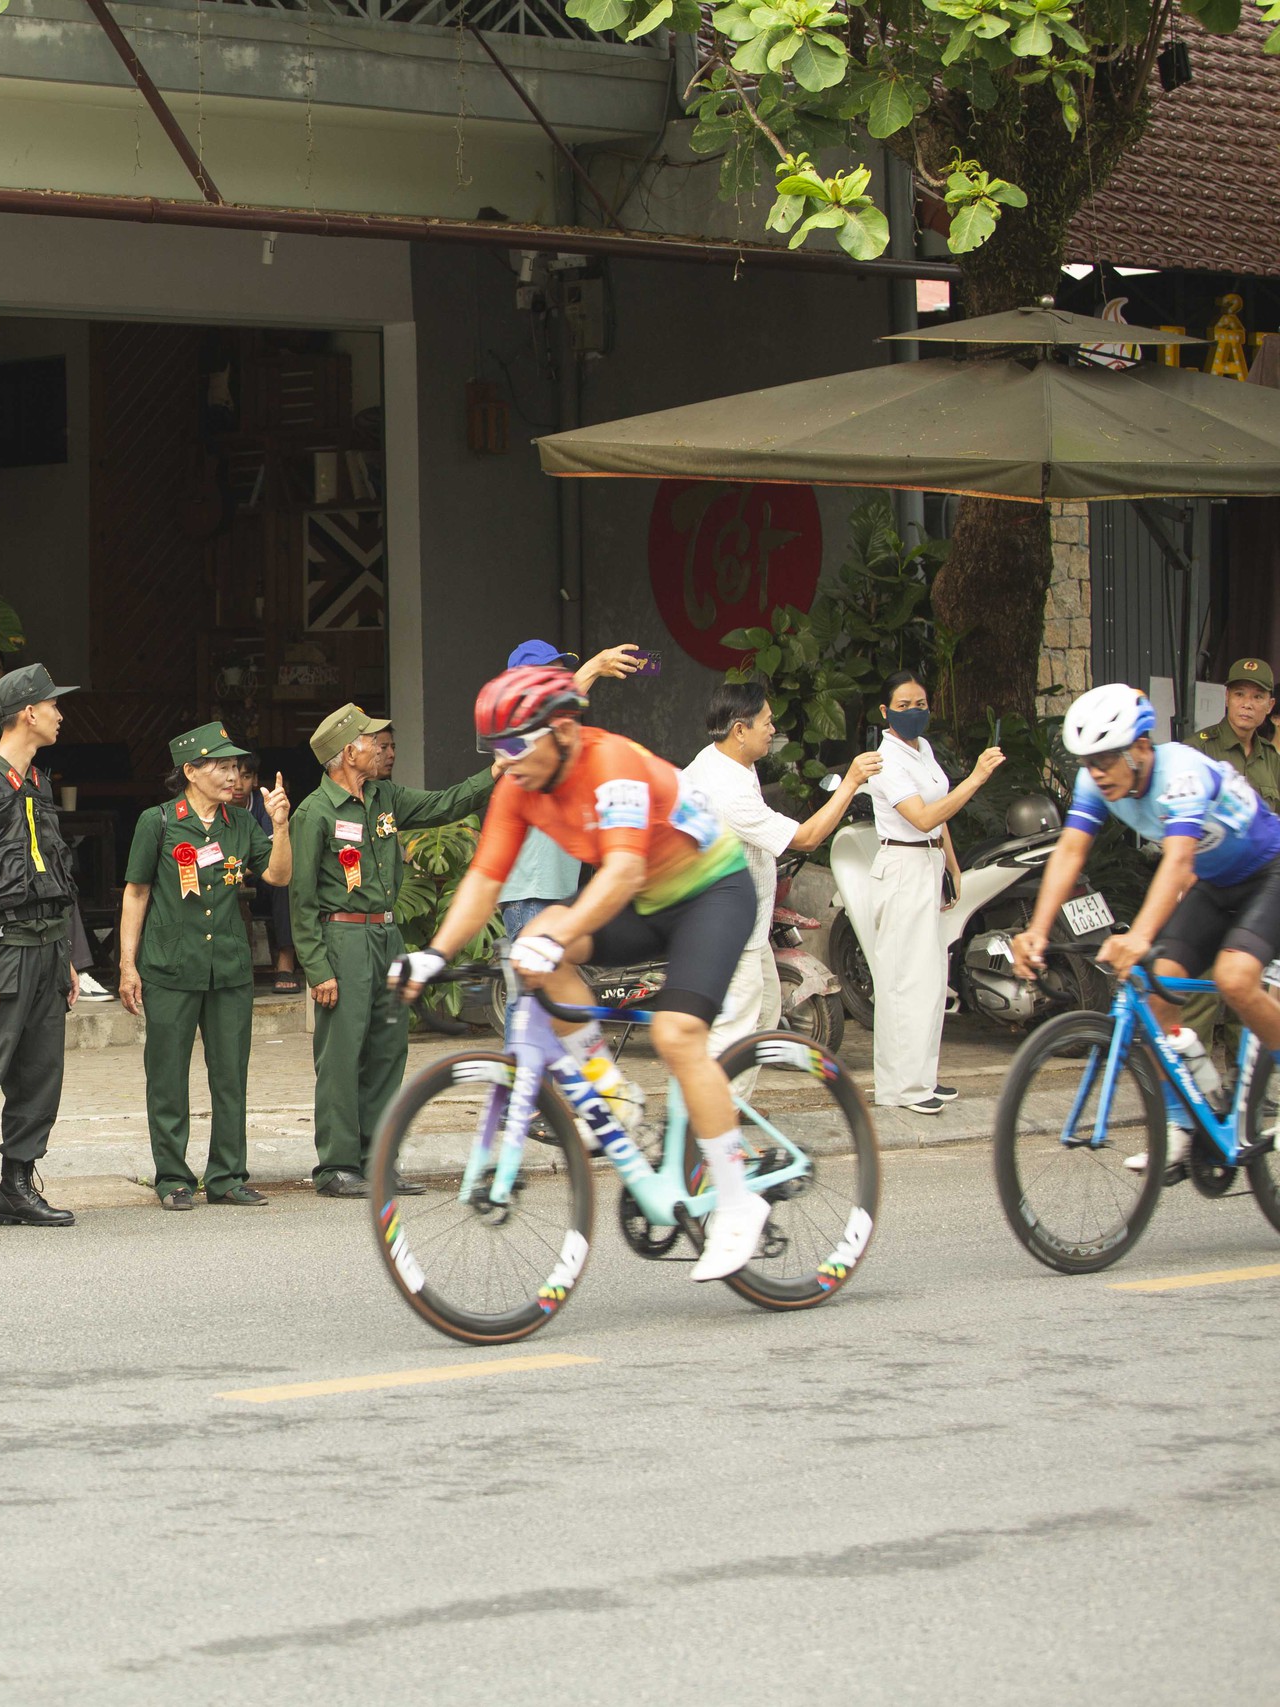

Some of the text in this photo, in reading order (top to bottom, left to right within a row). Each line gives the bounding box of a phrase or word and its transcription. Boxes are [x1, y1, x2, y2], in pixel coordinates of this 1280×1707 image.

[1068, 895, 1099, 917] 74-E1
[1072, 909, 1110, 933] 108.11
[601, 987, 626, 999] JVC
